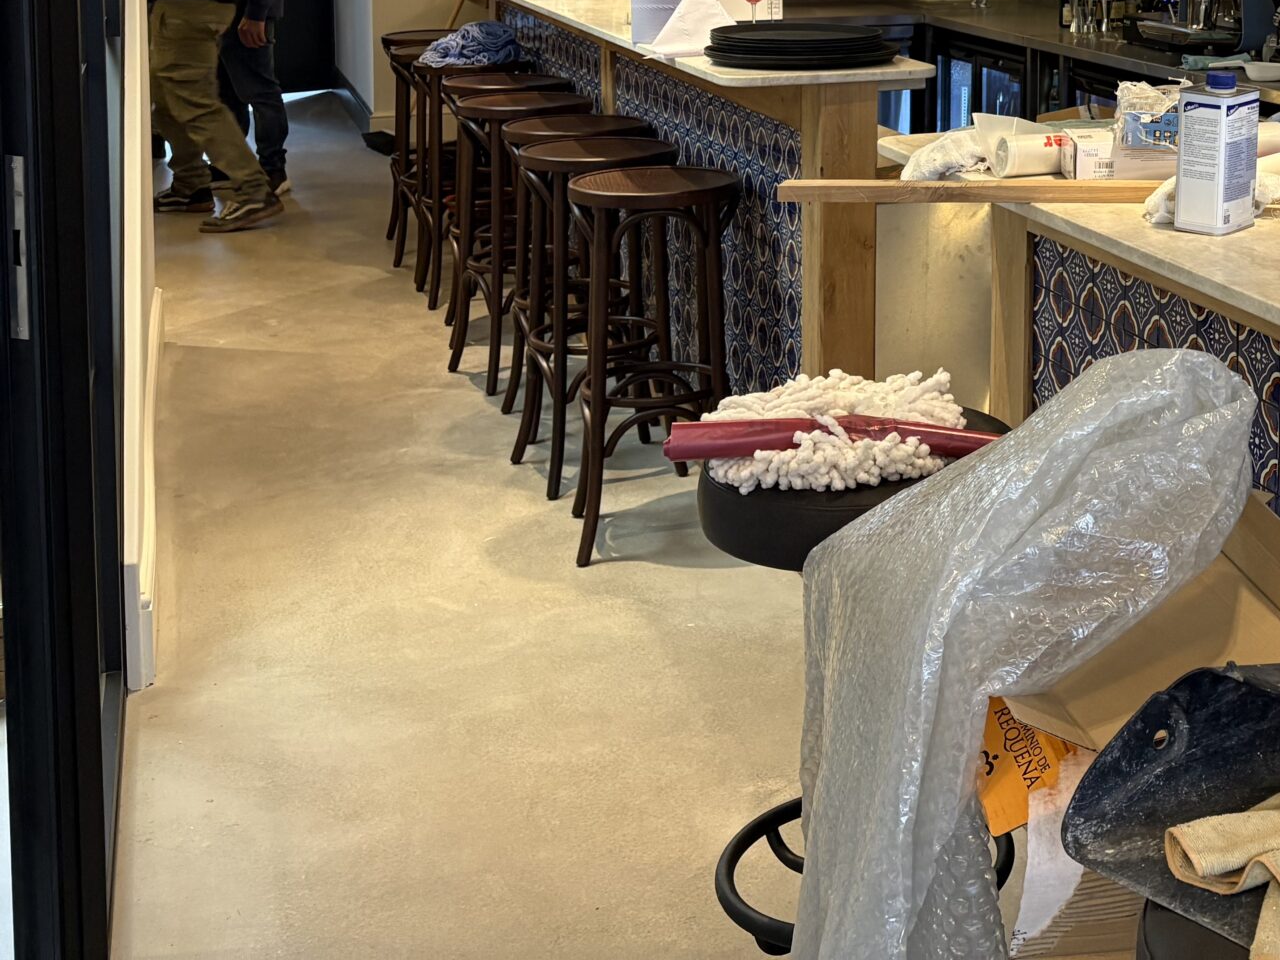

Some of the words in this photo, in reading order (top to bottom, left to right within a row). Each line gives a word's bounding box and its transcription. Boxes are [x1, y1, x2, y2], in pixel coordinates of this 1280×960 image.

[993, 706, 1042, 790] REQUENA
[1018, 721, 1043, 757] MINIO
[1037, 756, 1051, 774] DE
